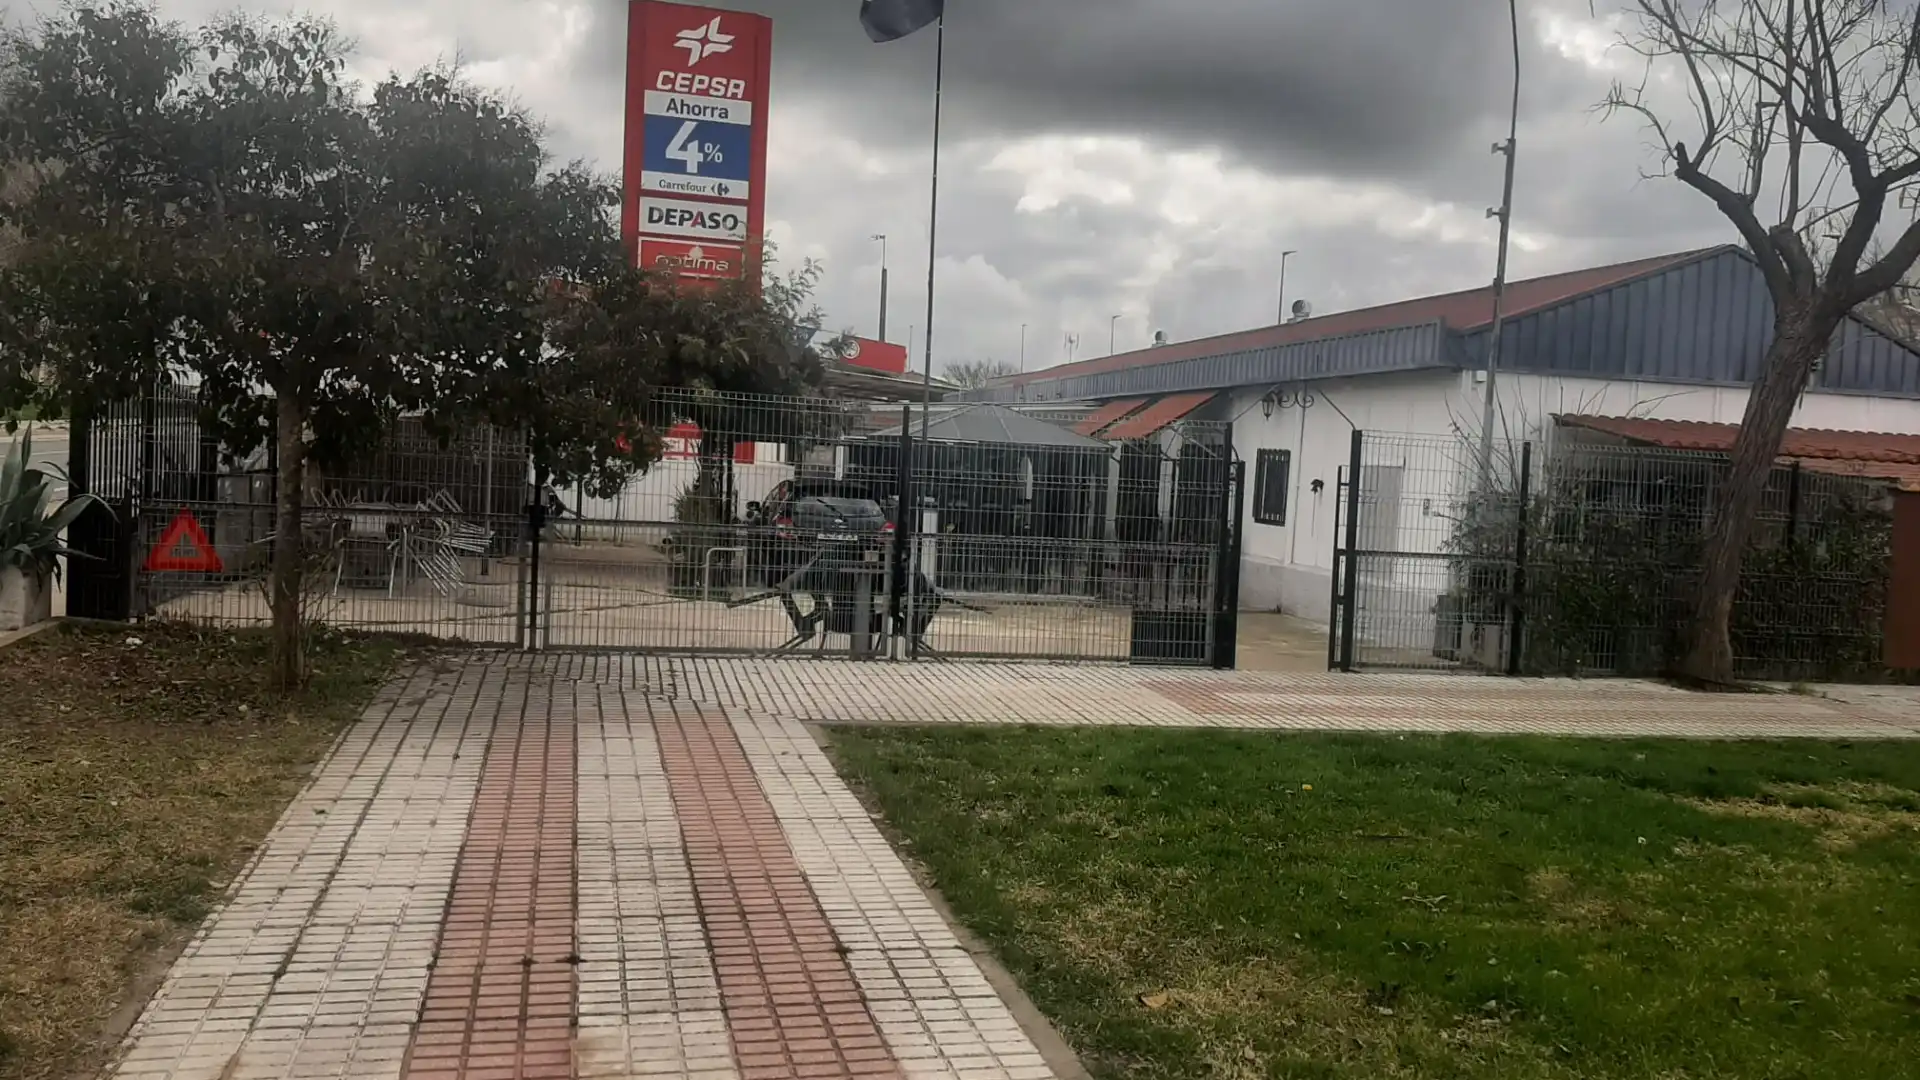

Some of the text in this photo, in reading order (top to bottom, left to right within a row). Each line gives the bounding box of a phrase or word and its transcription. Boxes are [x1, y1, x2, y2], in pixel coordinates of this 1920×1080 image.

[656, 70, 746, 99] CEPSA
[666, 98, 729, 119] Ahorra
[659, 179, 707, 193] Carrefour
[647, 206, 739, 231] DEPASO
